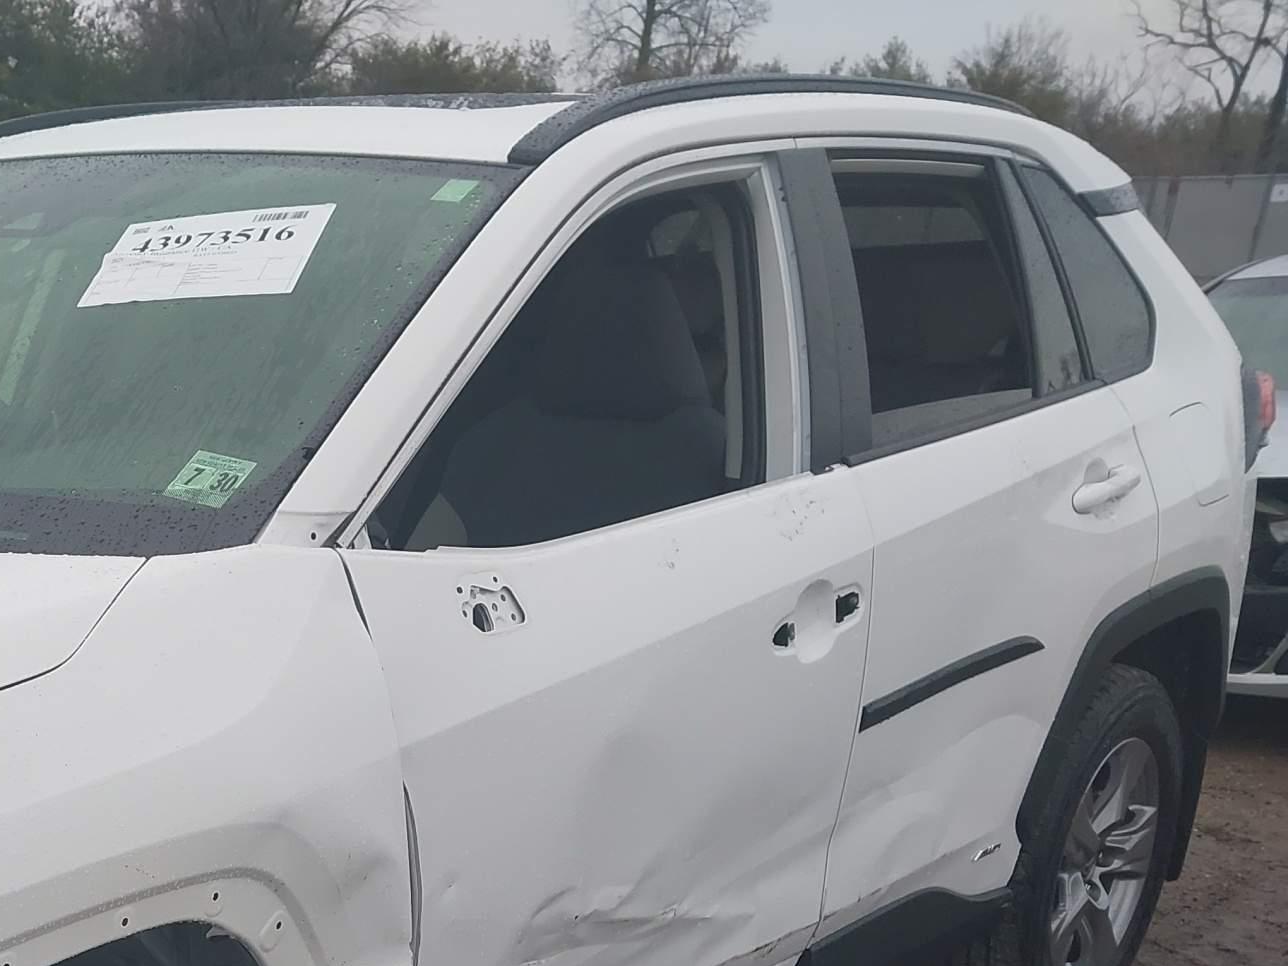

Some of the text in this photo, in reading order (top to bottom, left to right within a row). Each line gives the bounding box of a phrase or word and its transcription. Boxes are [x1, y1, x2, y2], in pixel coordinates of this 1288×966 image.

[132, 223, 297, 254] 43973516
[184, 467, 239, 493] 7 30
